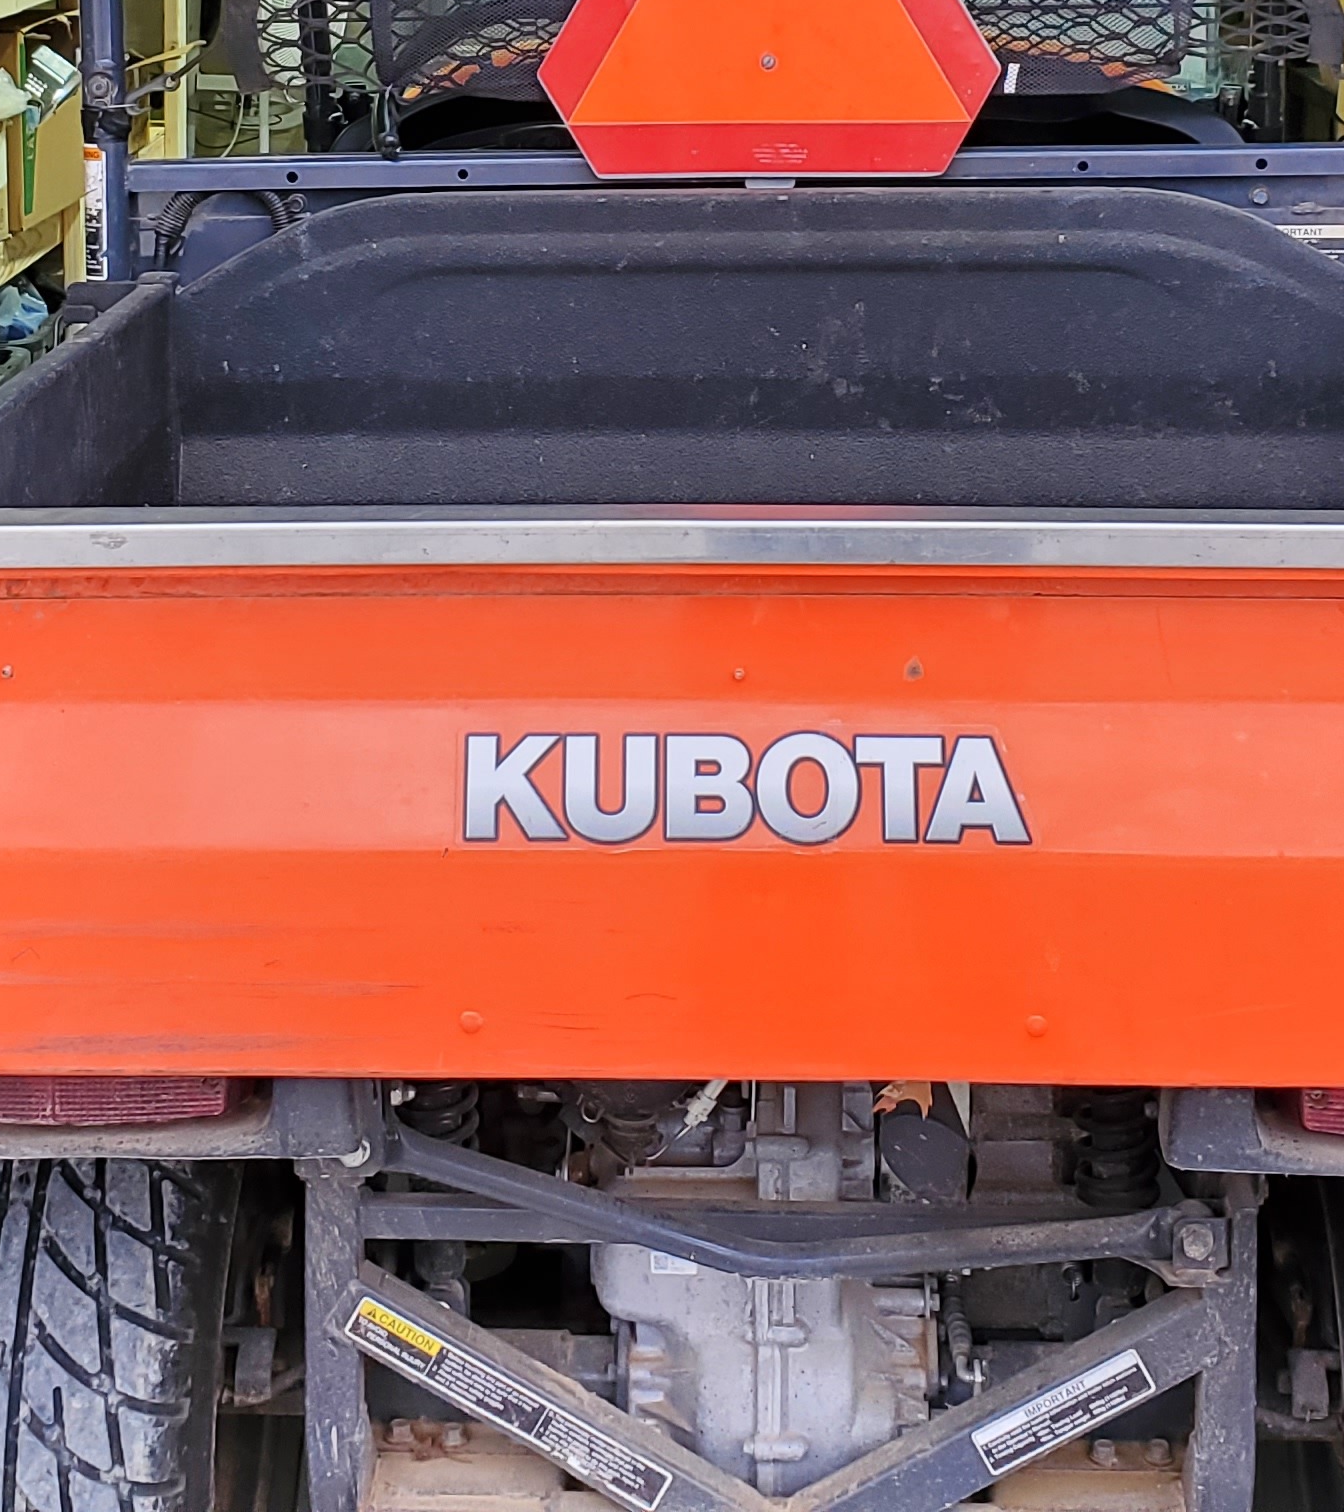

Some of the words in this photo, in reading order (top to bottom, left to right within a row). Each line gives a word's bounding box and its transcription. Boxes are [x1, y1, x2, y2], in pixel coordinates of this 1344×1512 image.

[1283, 228, 1323, 236] ORTANT
[463, 731, 1034, 845] KUBOTA
[379, 1314, 435, 1352] CAUTION
[1023, 1380, 1086, 1419] IMPORTANT
